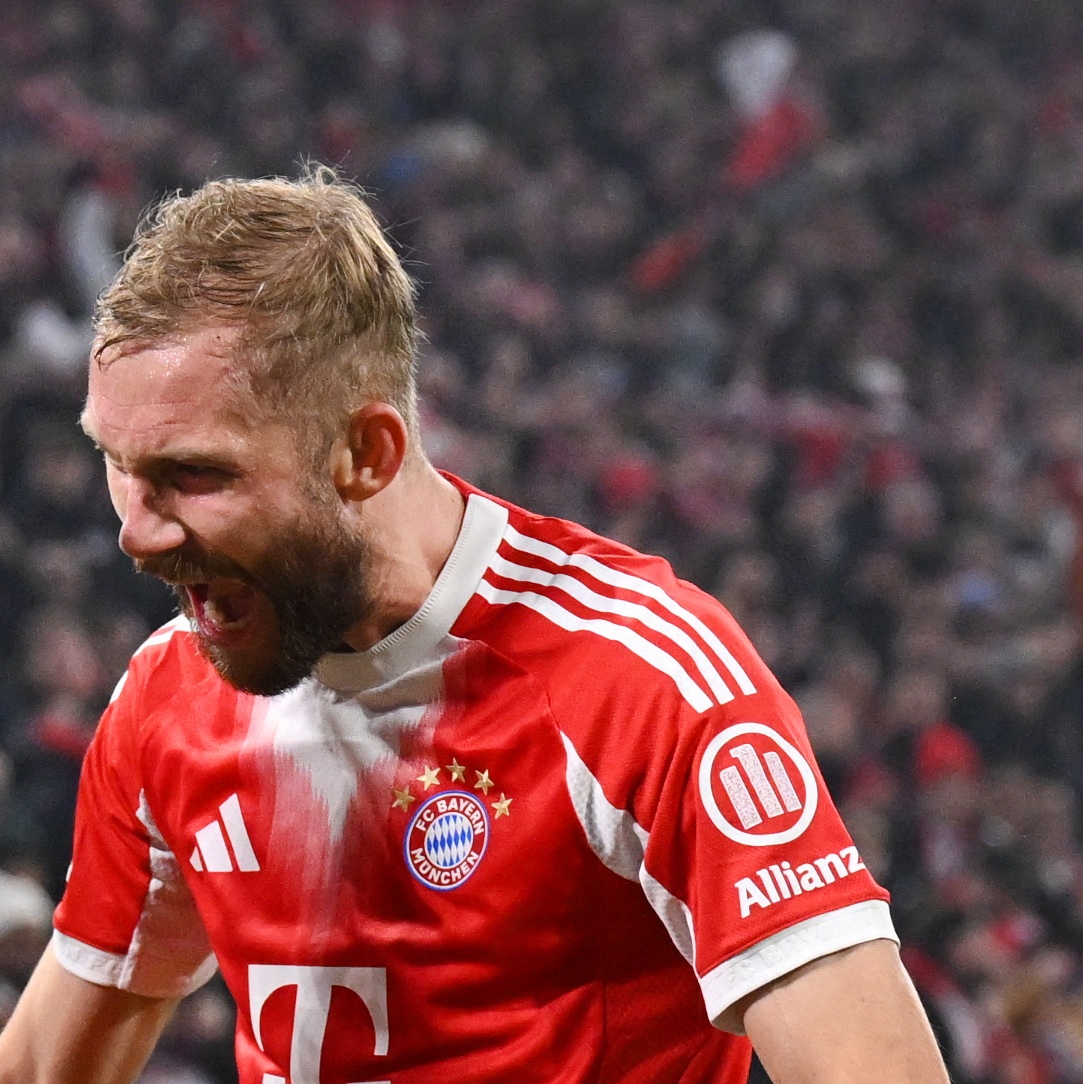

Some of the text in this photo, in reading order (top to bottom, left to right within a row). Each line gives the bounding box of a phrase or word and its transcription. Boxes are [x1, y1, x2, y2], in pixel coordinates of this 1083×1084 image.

[416, 797, 485, 836] FC BAYERN
[411, 847, 479, 884] MÜNCHEN
[734, 845, 867, 919] Allianz
